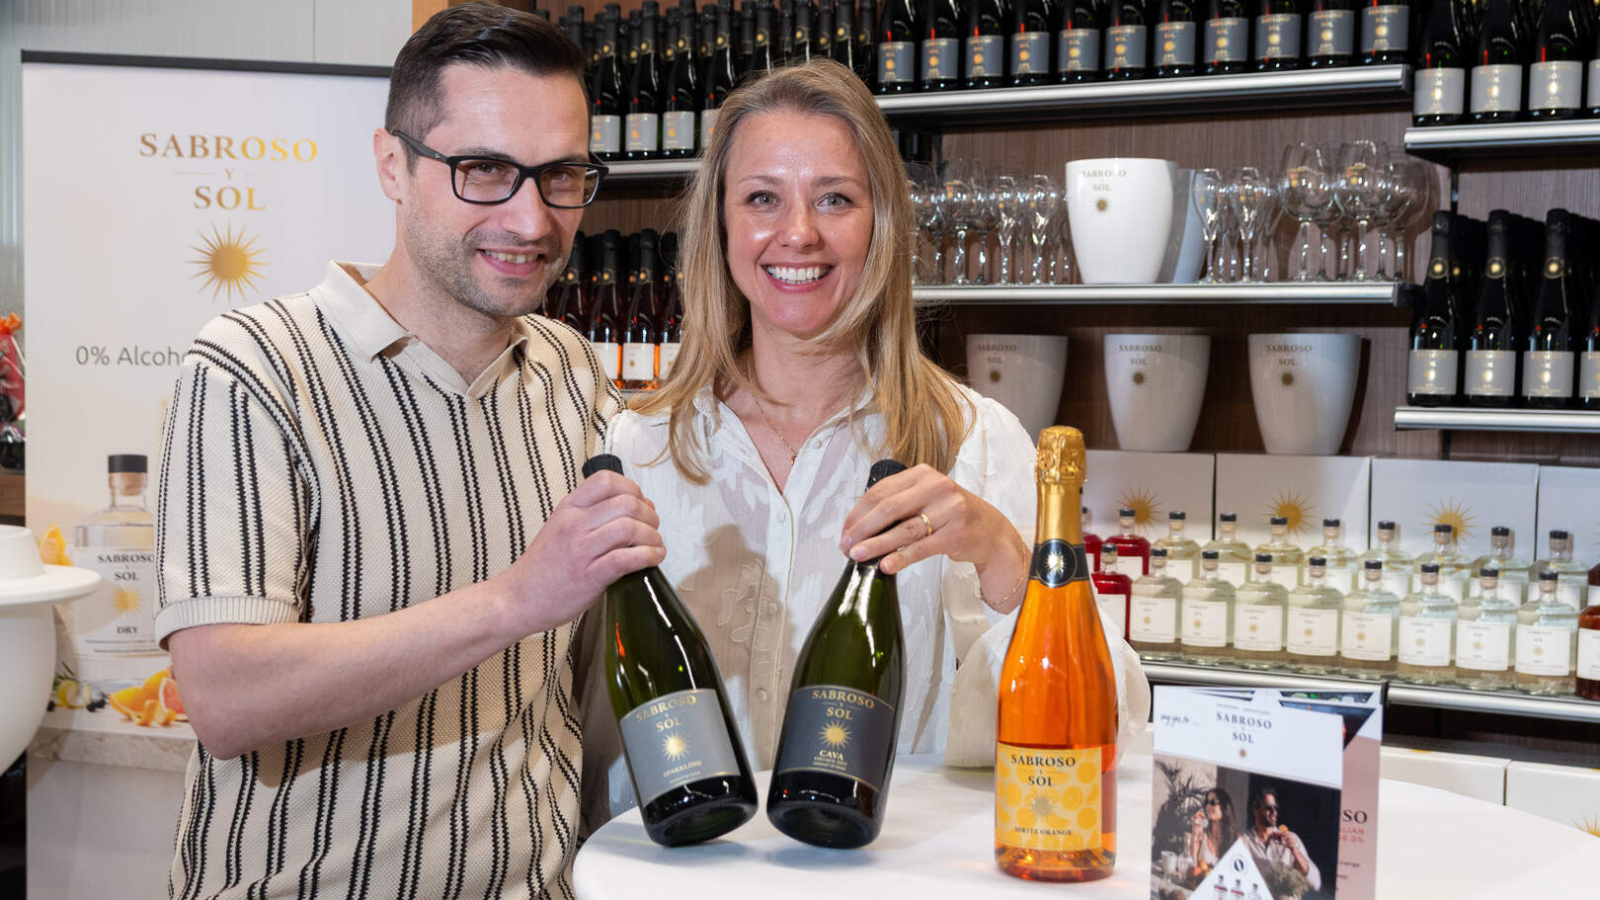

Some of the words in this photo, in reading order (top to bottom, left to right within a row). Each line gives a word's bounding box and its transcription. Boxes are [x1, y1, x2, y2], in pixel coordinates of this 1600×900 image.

[139, 132, 318, 163] SABROSO
[225, 169, 234, 180] Y
[193, 185, 267, 212] SOL
[76, 345, 111, 366] 0%
[114, 571, 139, 581] SOL
[116, 626, 138, 634] DRY
[812, 689, 875, 709] SABROSO
[636, 694, 697, 722] SABROSO
[826, 706, 853, 720] SOL
[656, 716, 682, 732] SOL
[1216, 711, 1272, 730] SABROSO
[1232, 731, 1254, 744] SOL
[819, 749, 844, 761] CAVA
[1011, 753, 1076, 768] SABROSO
[1028, 776, 1057, 787] SOL
[1040, 828, 1072, 836] ORANGE
